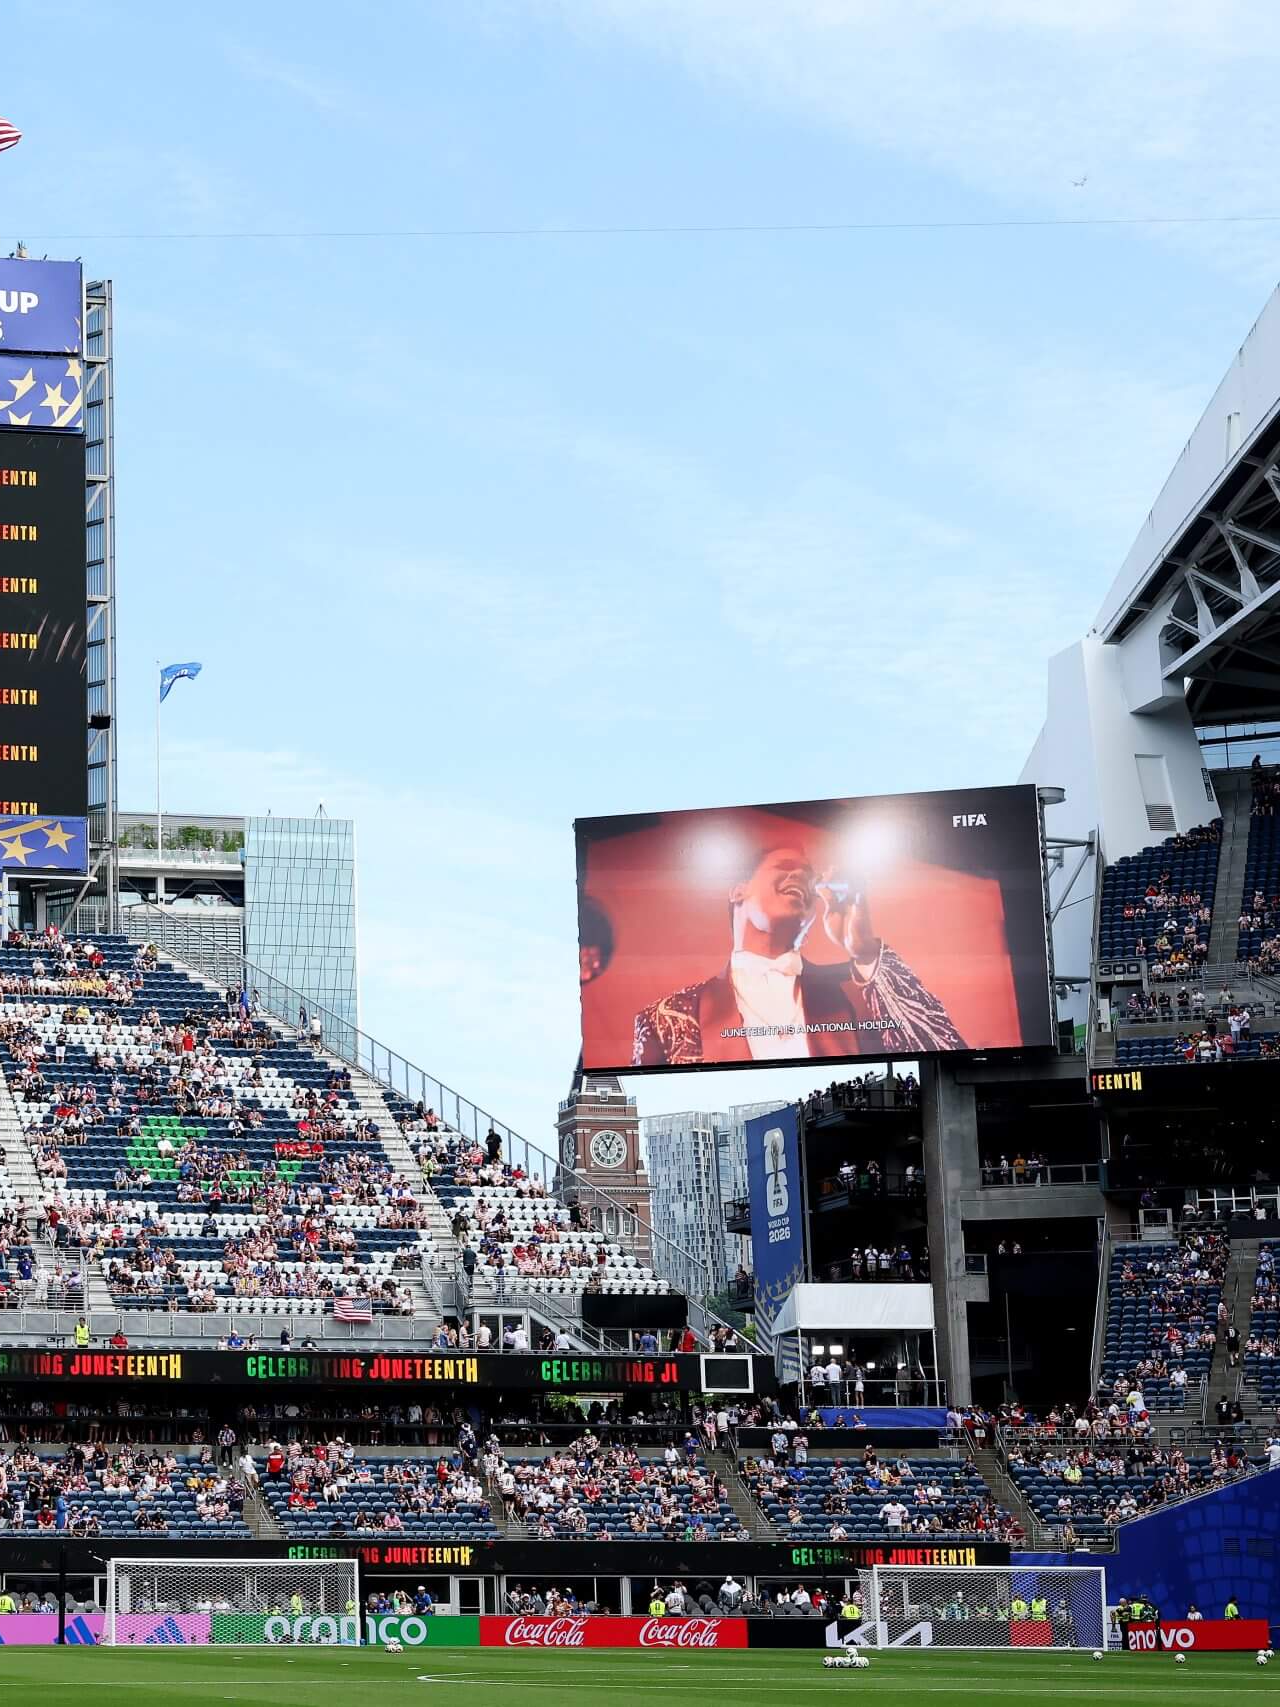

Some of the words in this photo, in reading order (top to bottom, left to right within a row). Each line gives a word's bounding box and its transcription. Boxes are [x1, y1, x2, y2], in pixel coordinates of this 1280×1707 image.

[952, 814, 988, 828] FIFA
[806, 1022, 857, 1033] NATIONAL
[768, 1226, 791, 1244] 2026
[69, 1353, 182, 1379] JUNETEENTH
[246, 1354, 362, 1380] CELEBRATING
[369, 1356, 478, 1382] JUNETEENTH
[384, 1546, 471, 1566] JUNETEENTH
[889, 1547, 976, 1566] JUNETEENTH
[264, 1616, 428, 1645] aramco
[505, 1617, 588, 1647] Coca-Cola
[639, 1618, 722, 1647] Coca-Cola
